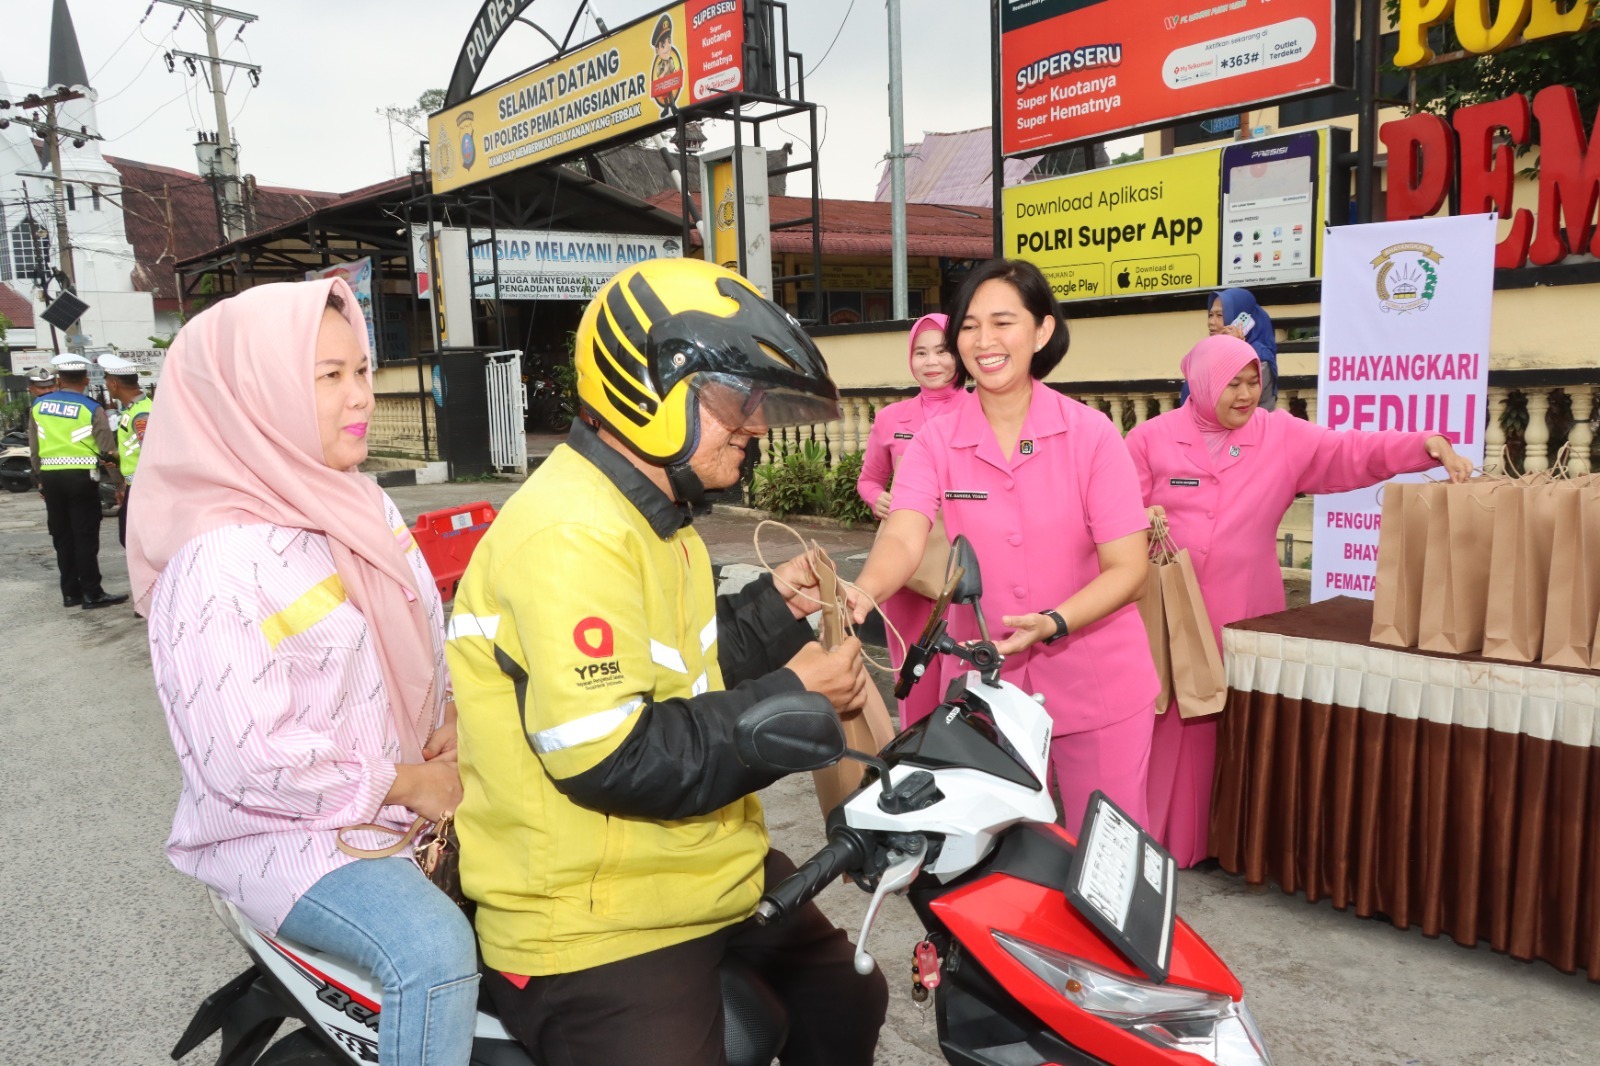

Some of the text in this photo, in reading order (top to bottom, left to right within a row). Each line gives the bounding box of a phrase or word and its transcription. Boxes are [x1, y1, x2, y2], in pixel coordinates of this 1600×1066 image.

[702, 30, 732, 47] Kuotanya
[1230, 31, 1261, 45] sekarang
[1261, 29, 1268, 37] di
[1274, 40, 1297, 51] Outlet
[703, 54, 733, 71] Hematnya
[1269, 47, 1302, 60] Terdekat
[499, 50, 619, 120] SELAMAT DATANG
[1017, 74, 1117, 110] Super Kuotanya
[484, 74, 645, 153] DI POLRES PEMATANGSIANTAR
[1017, 95, 1121, 130] Super Hematnya
[502, 151, 515, 163] SIAP
[515, 136, 553, 160] MEMBERIKAN
[553, 124, 590, 145] PELAYANAN
[590, 117, 610, 132] YANG
[611, 103, 642, 125] TERBAIK
[1016, 181, 1164, 218] Download Aplikasi
[1017, 216, 1203, 254] POLRI Super App
[496, 240, 531, 260] SIAP
[535, 241, 612, 263] MELAYANI
[615, 244, 658, 263] ANDA
[1135, 264, 1175, 274] Download di
[479, 275, 502, 284] KAI
[504, 275, 529, 284] JUGA
[530, 276, 594, 285] MENYEDIAKAN
[500, 285, 554, 293] PENGADUAN
[1051, 279, 1099, 295] oogle Play
[1135, 272, 1193, 290] App Store
[1328, 353, 1479, 382] BHAYANGKARI
[40, 402, 79, 417] POLISI
[1328, 394, 1477, 445] PEDULI
[1327, 511, 1381, 530] PENGUR
[1344, 543, 1379, 561] BHAY
[946, 706, 961, 724] OND
